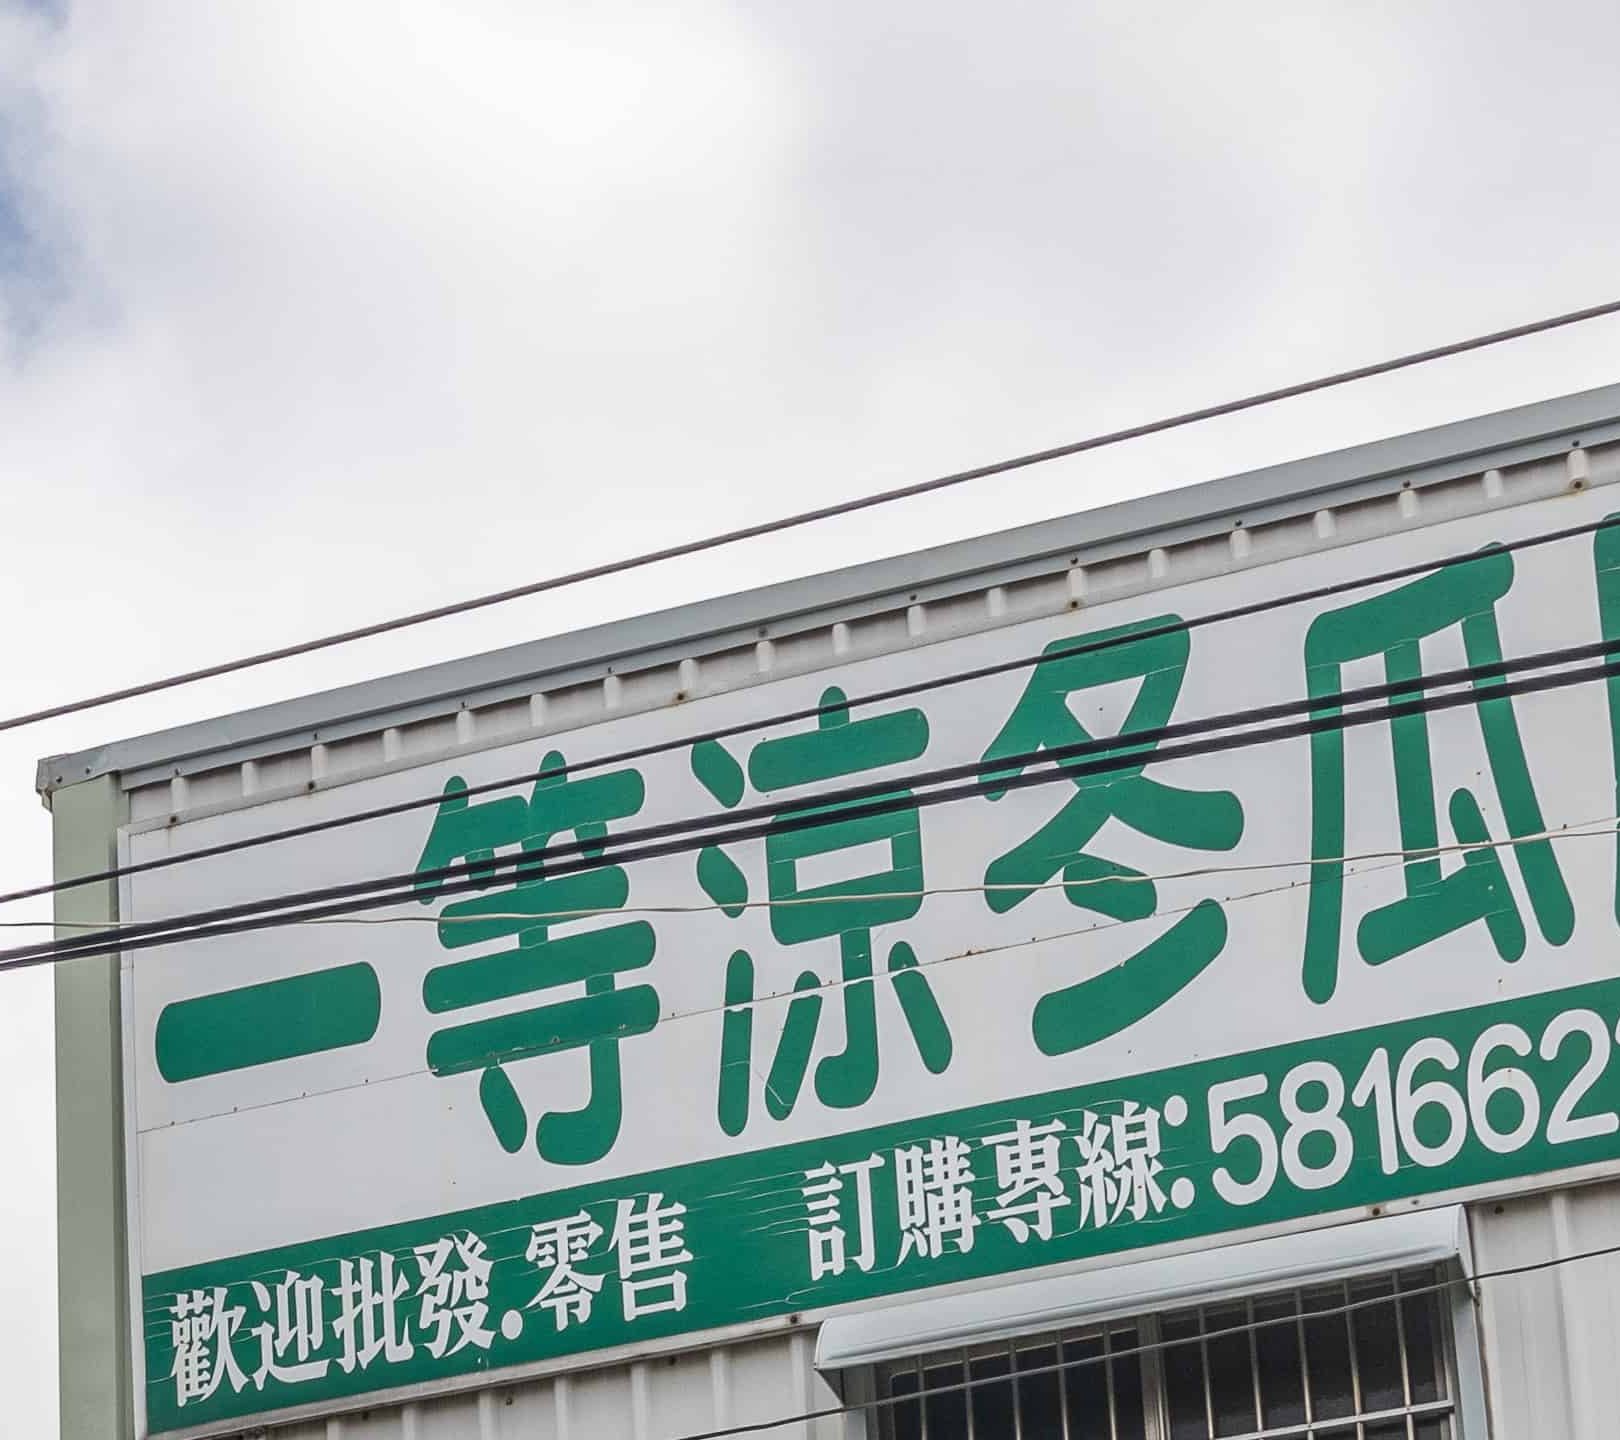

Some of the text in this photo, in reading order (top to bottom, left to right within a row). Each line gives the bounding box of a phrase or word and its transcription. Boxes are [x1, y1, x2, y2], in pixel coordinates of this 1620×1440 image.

[166, 1196, 692, 1418] 歡迎批發.零售
